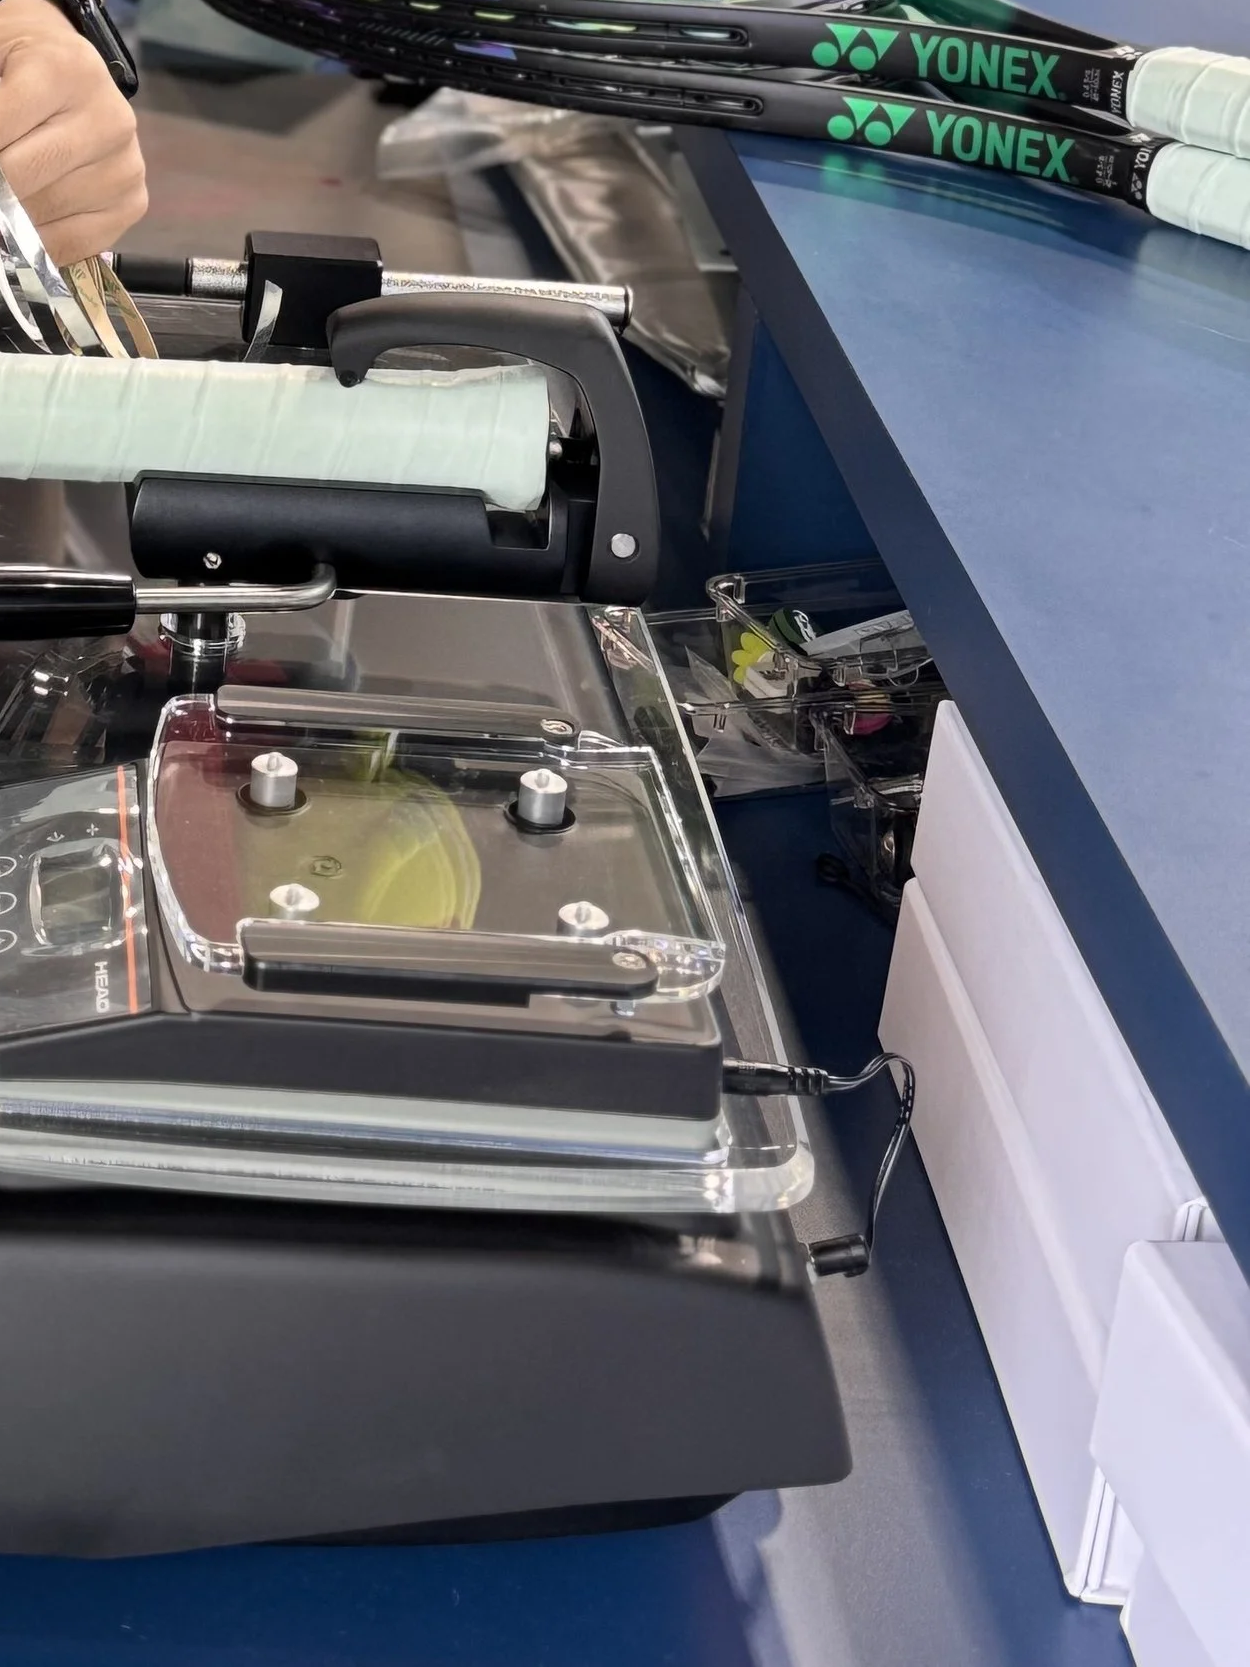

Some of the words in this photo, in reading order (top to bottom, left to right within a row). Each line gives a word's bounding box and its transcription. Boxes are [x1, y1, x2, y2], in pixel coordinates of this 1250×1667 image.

[910, 32, 1061, 100] YONEX
[1110, 70, 1125, 114] YONEX
[926, 110, 1076, 184] YONEX
[93, 961, 110, 1014] HEAD
